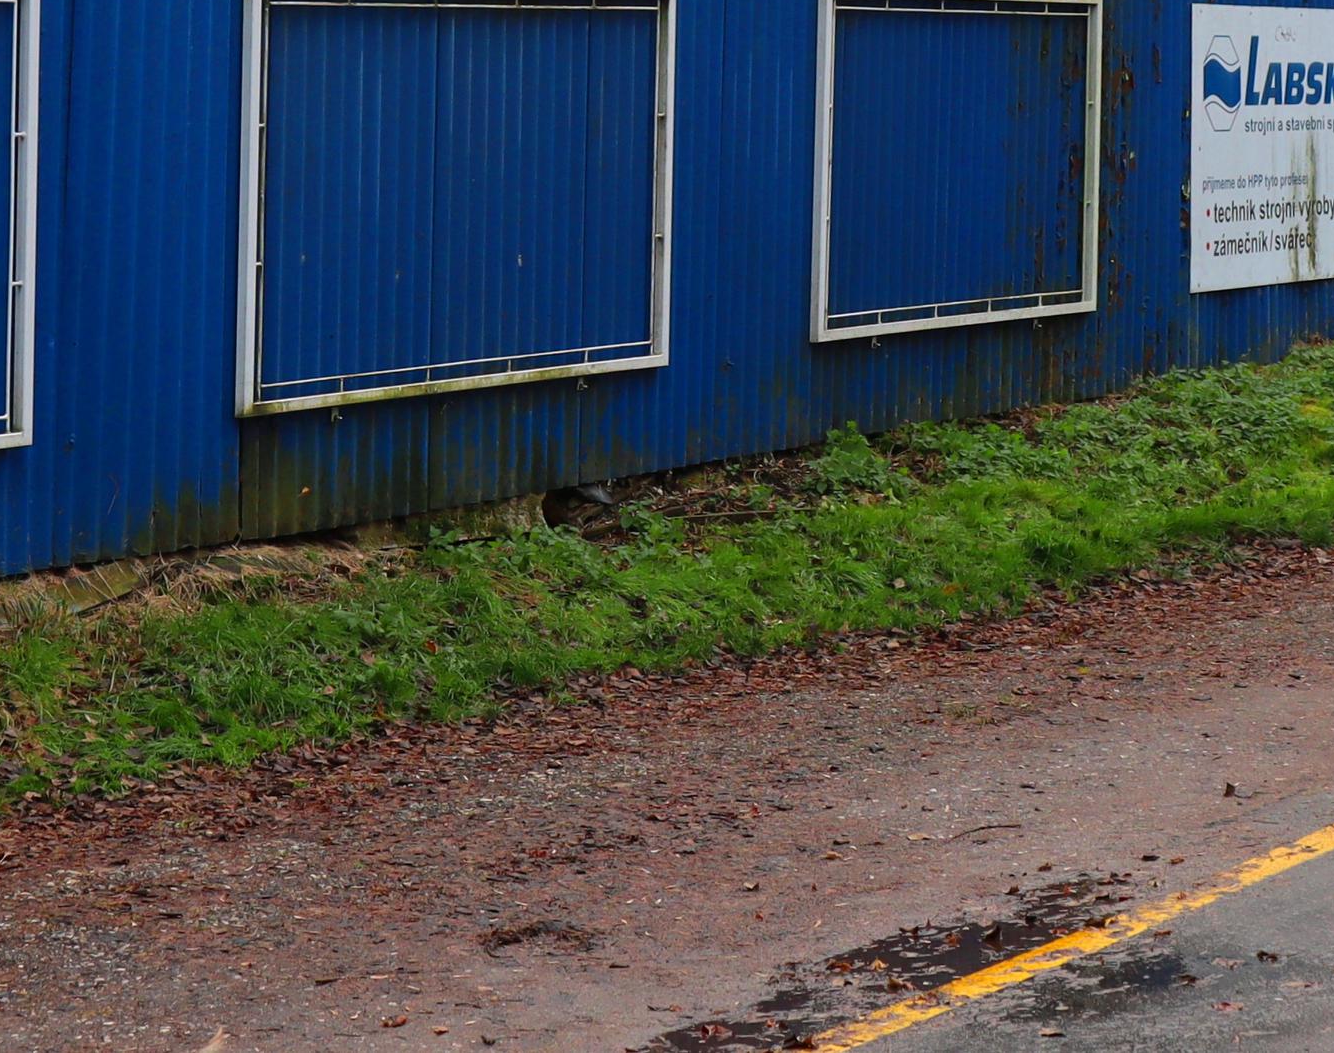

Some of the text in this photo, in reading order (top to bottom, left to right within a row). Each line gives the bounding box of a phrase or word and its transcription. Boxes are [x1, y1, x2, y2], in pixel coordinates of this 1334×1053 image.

[1244, 116, 1276, 136] strojní
[1277, 120, 1284, 132] a
[1285, 115, 1326, 132] stavební
[1237, 175, 1247, 189] do
[1248, 174, 1263, 188] HPP
[1265, 174, 1279, 191] tyto
[1213, 198, 1257, 224] technik
[1258, 195, 1297, 225] strojní
